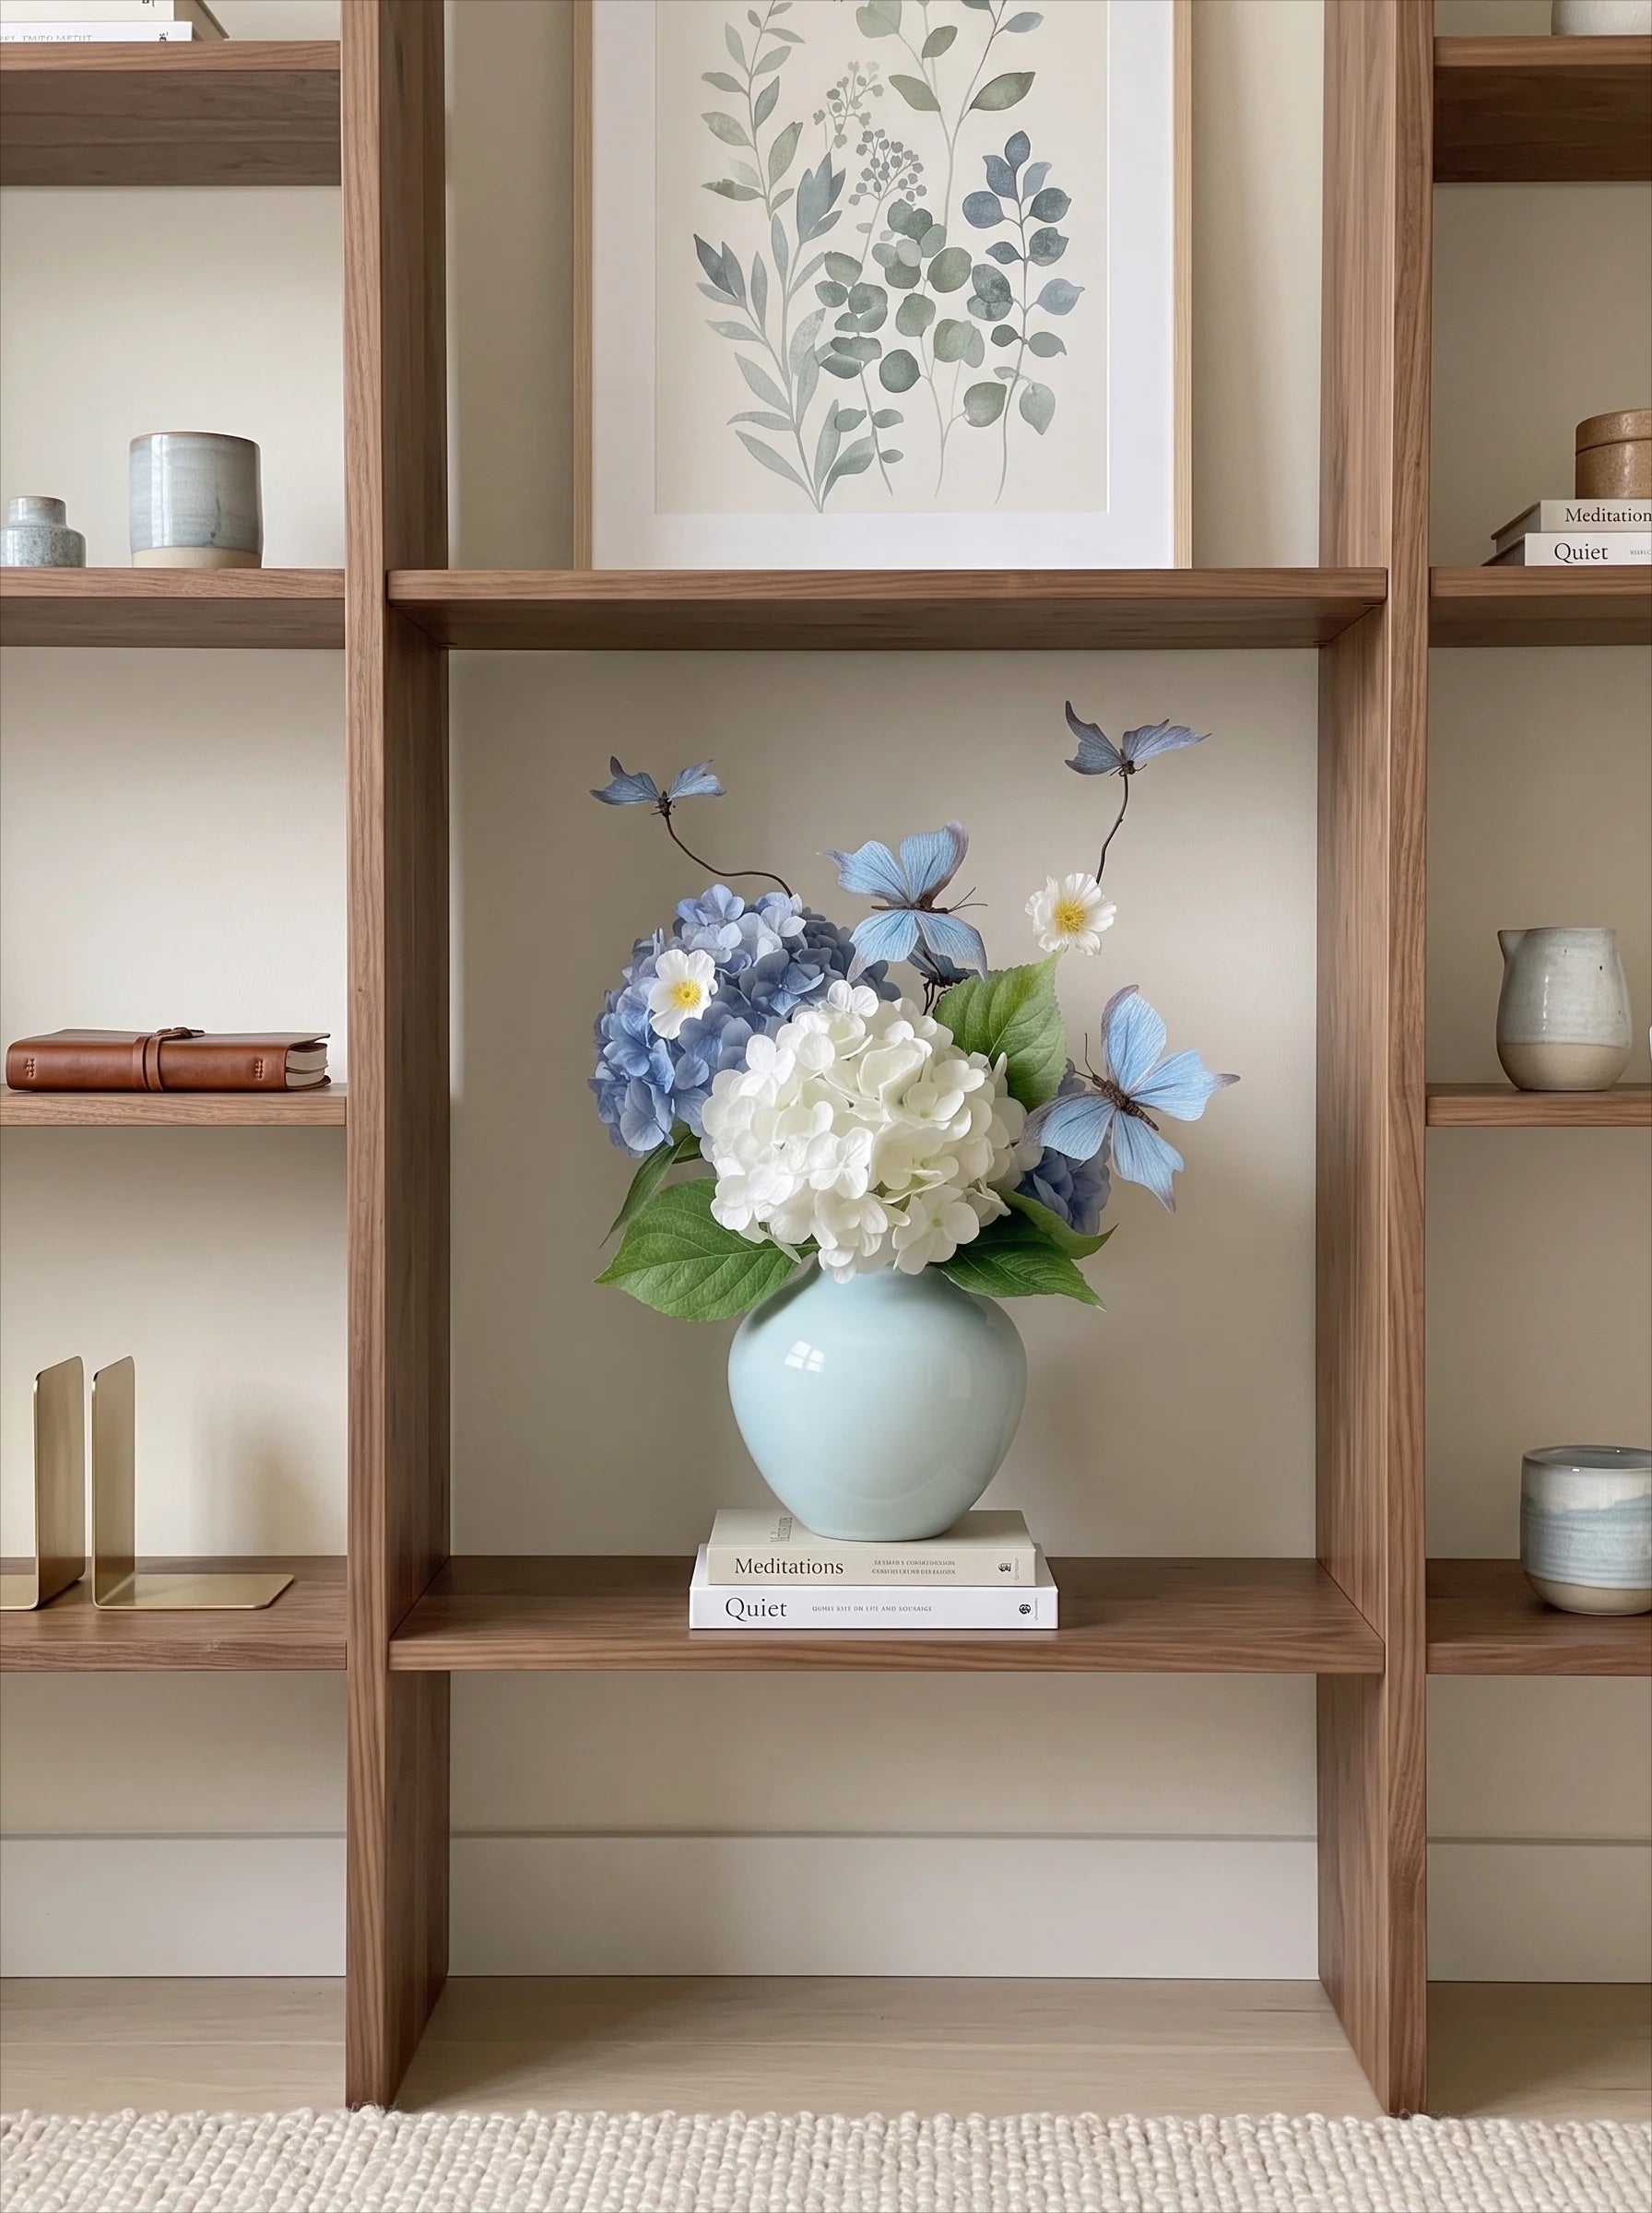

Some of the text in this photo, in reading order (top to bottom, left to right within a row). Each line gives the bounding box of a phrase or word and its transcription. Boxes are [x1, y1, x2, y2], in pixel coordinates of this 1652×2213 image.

[1564, 506, 1652, 523] Meditation
[1553, 542, 1609, 564] Quiet
[735, 1557, 844, 1575] Meditations
[725, 1597, 787, 1623] Quiet
